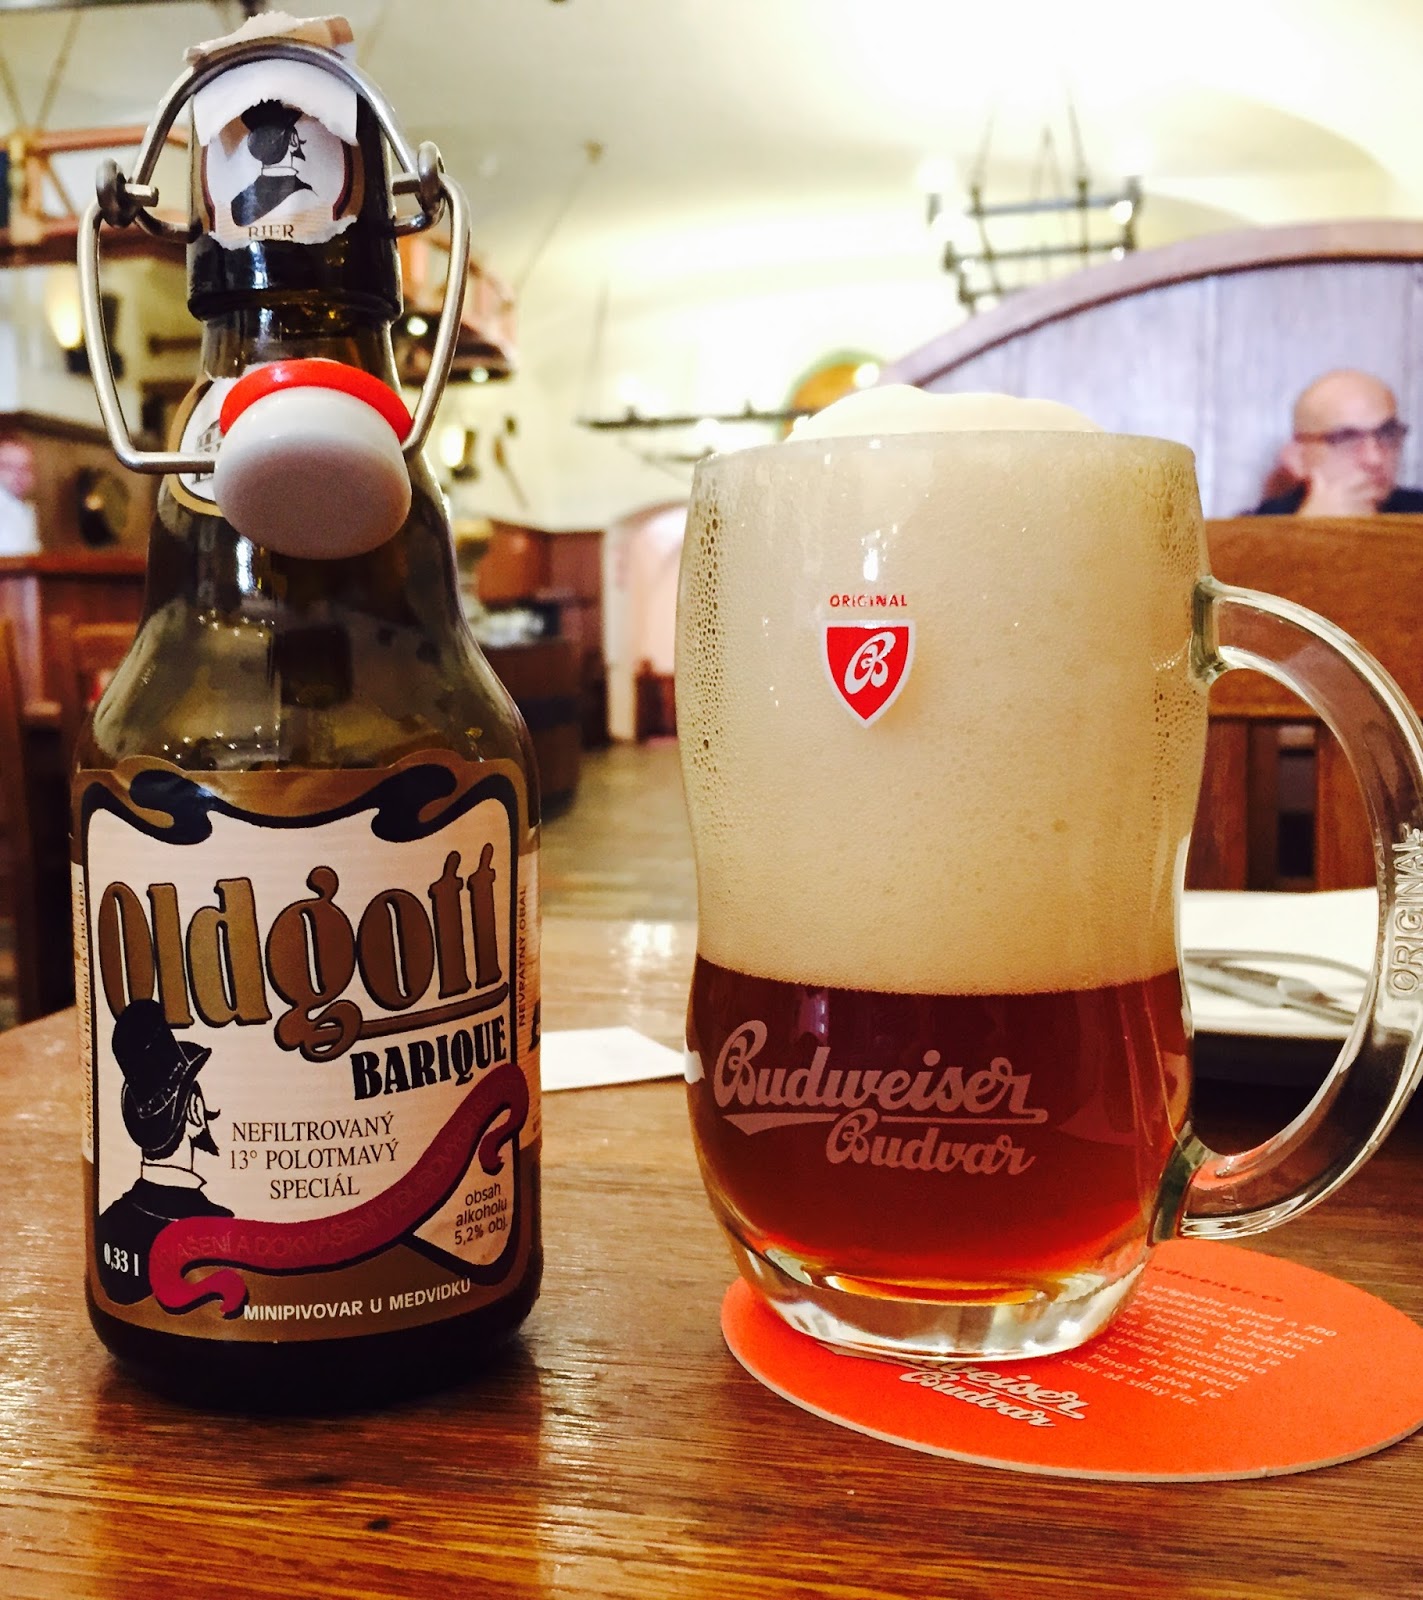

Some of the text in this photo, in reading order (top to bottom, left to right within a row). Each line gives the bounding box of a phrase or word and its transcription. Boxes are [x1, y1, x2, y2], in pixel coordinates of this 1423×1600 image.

[829, 594, 908, 608] ORIGINAL
[518, 888, 527, 931] OBAL
[1390, 826, 1423, 996] ORIGINAL
[350, 1015, 507, 1100] BARIQUE
[714, 1020, 1048, 1124] Budweiser
[232, 1111, 395, 1142] NEFILTROVANÝ
[826, 1108, 1035, 1175] Budvar
[265, 1138, 399, 1170] POLOTMAVÝ
[270, 1173, 360, 1199] SPECIÁL
[465, 1182, 501, 1206] obsah
[455, 1198, 508, 1227] alkoholu
[454, 1224, 484, 1246] 5,2%
[104, 1242, 129, 1273] 0,33
[243, 1299, 364, 1321] MINIPIVOVAR
[369, 1298, 383, 1314] U
[1150, 1375, 1191, 1389] piva
[900, 1371, 1056, 1427] Budvar
